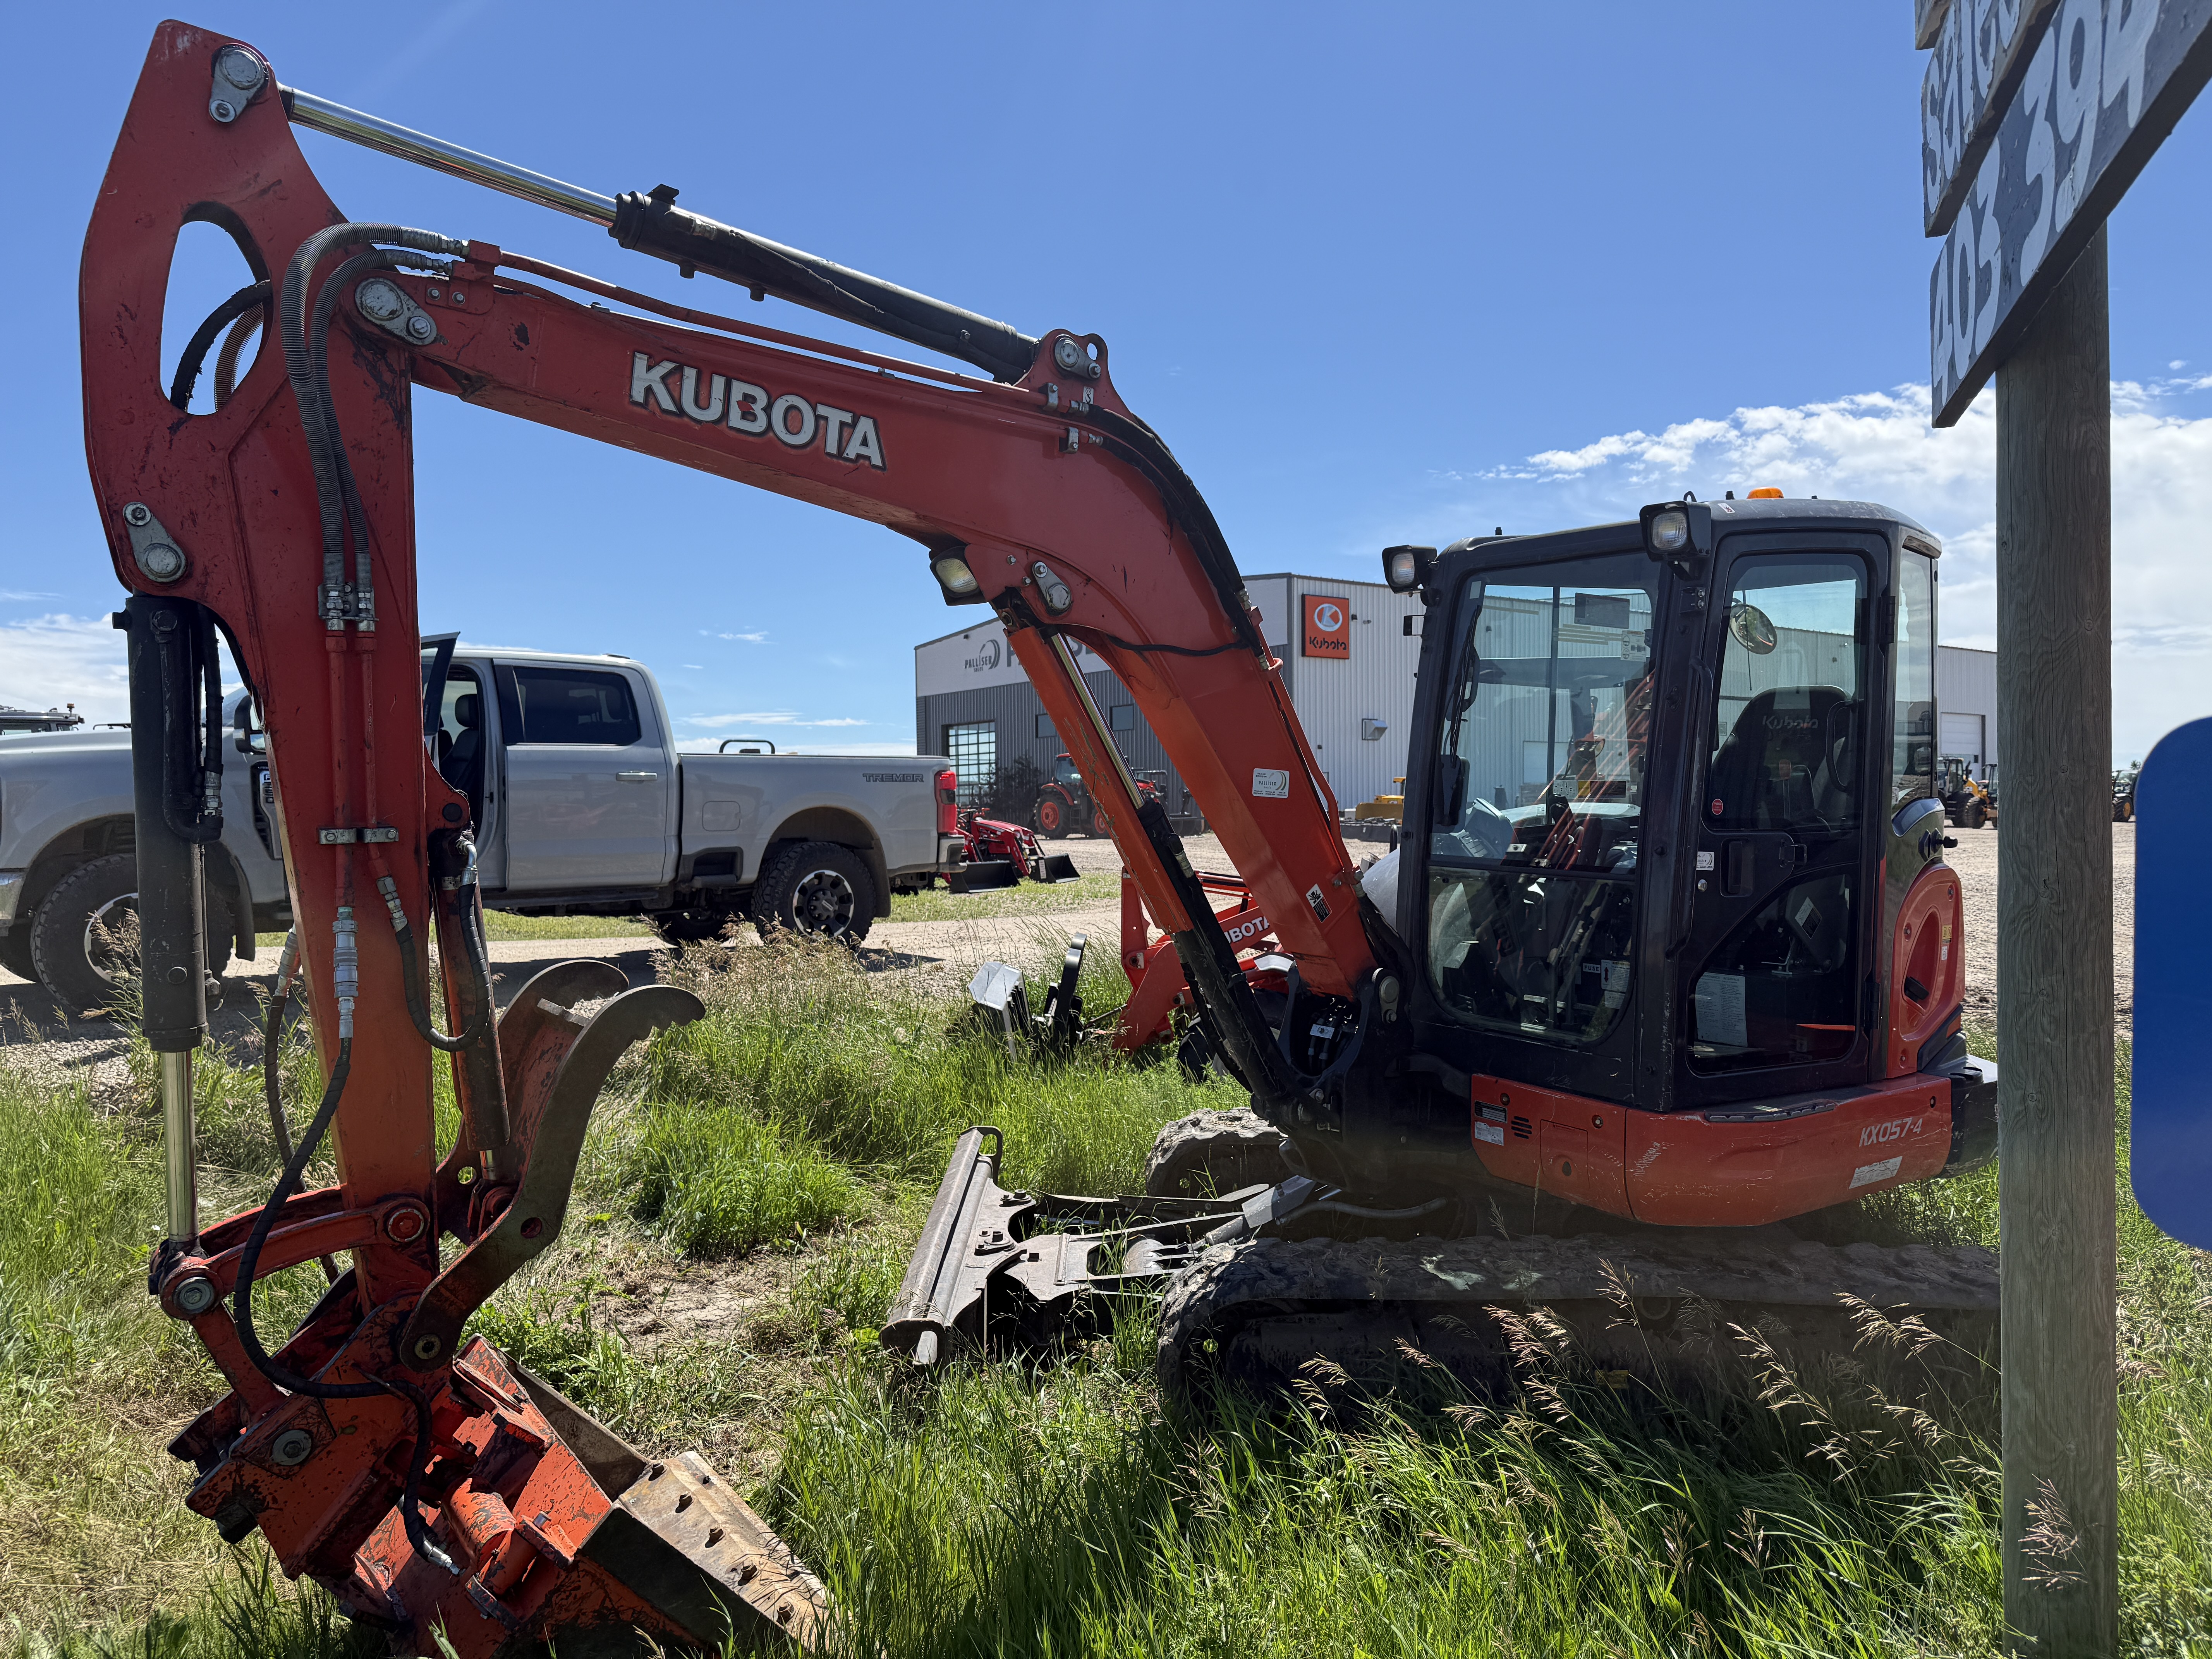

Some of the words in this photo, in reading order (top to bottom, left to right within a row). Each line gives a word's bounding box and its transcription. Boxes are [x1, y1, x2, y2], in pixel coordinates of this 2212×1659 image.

[1926, 0, 2019, 214] Sale
[1934, 137, 2001, 407] 403
[629, 351, 885, 469] KUBOTA
[1309, 636, 1346, 650] Kubota
[964, 655, 992, 669] PALLISER
[1762, 715, 1819, 729] Kubota
[863, 773, 924, 782] TREMOR
[1859, 1117, 1923, 1147] KX057-4
